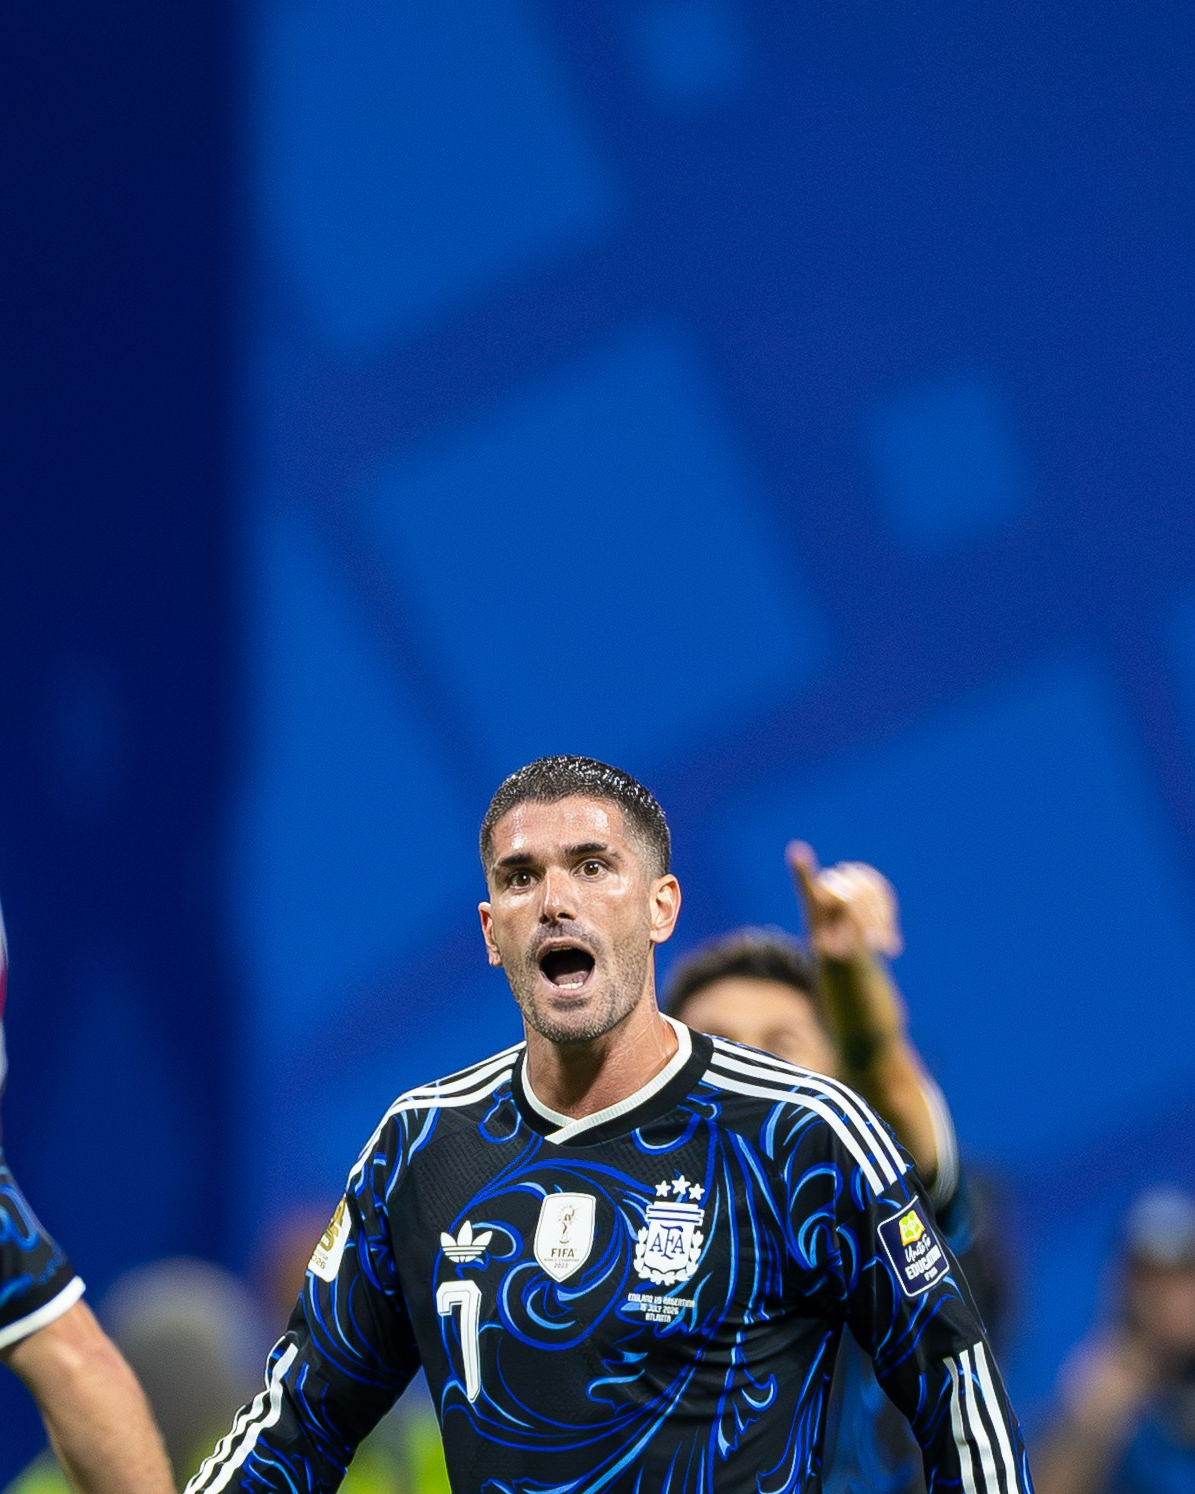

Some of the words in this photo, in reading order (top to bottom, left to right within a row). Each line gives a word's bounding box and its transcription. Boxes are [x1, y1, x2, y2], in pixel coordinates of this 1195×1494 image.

[551, 1248, 575, 1258] FIFA
[649, 1224, 685, 1260] AFA
[663, 1305, 680, 1315] 2026
[436, 1280, 482, 1403] 7
